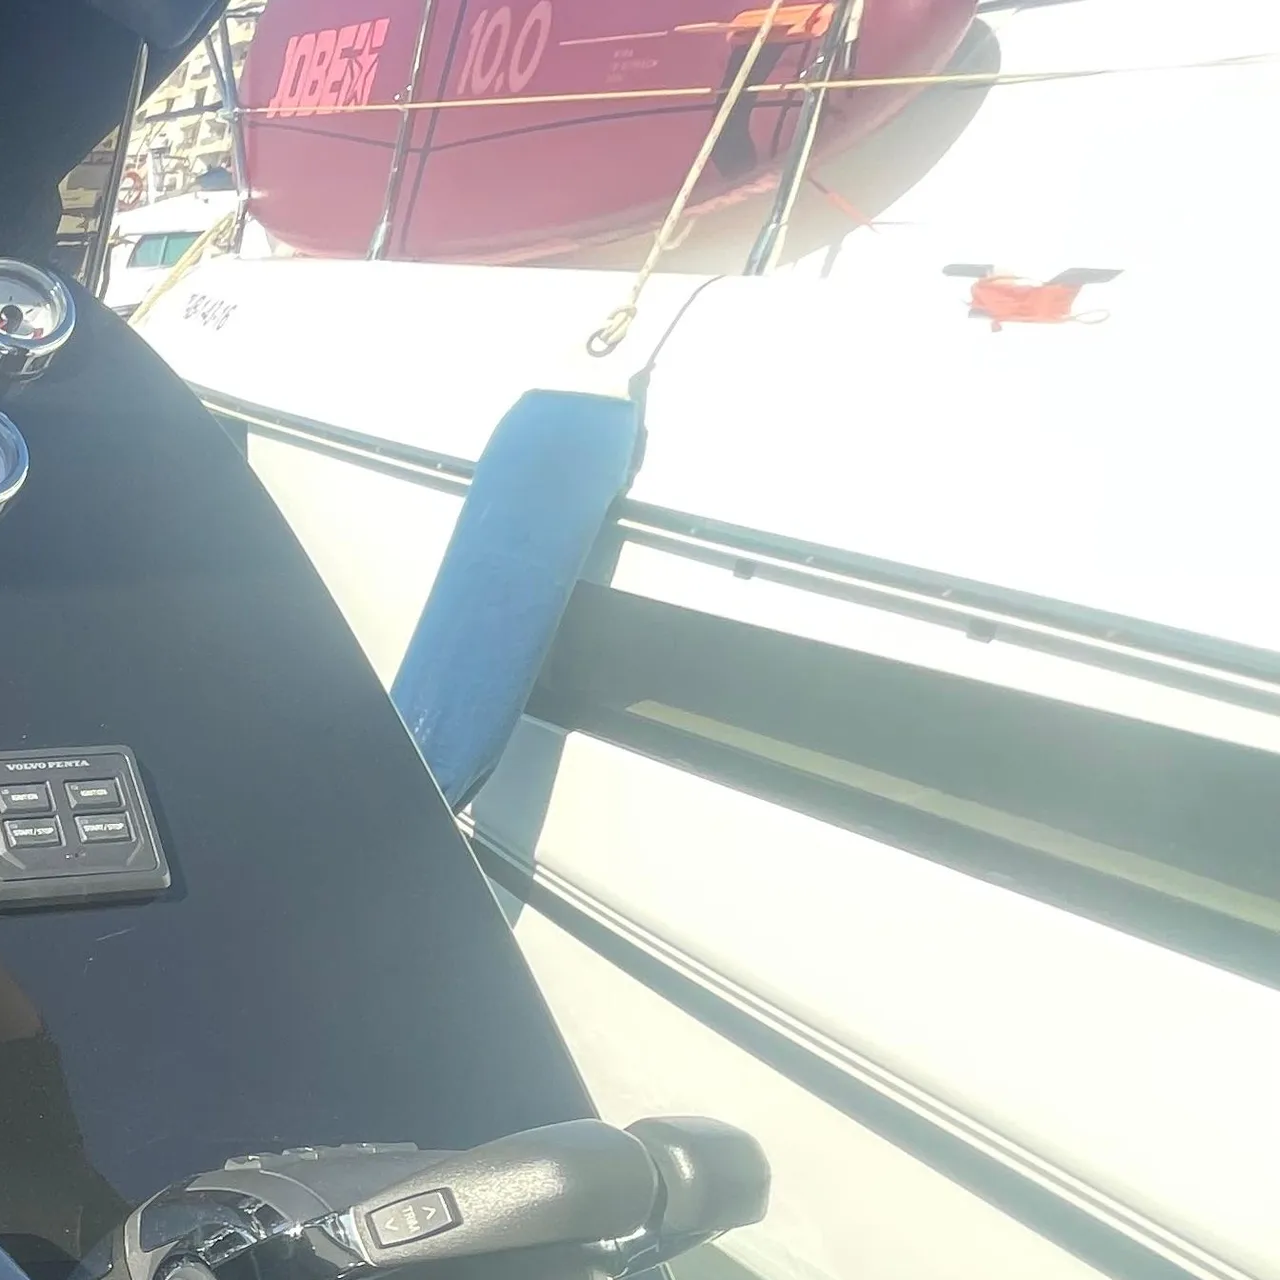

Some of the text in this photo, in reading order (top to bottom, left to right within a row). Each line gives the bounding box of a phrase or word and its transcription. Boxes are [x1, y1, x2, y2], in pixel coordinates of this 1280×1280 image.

[457, 3, 552, 95] 10.0
[5, 759, 90, 771] VOLVO PENTA
[402, 1204, 421, 1233] TRIM
